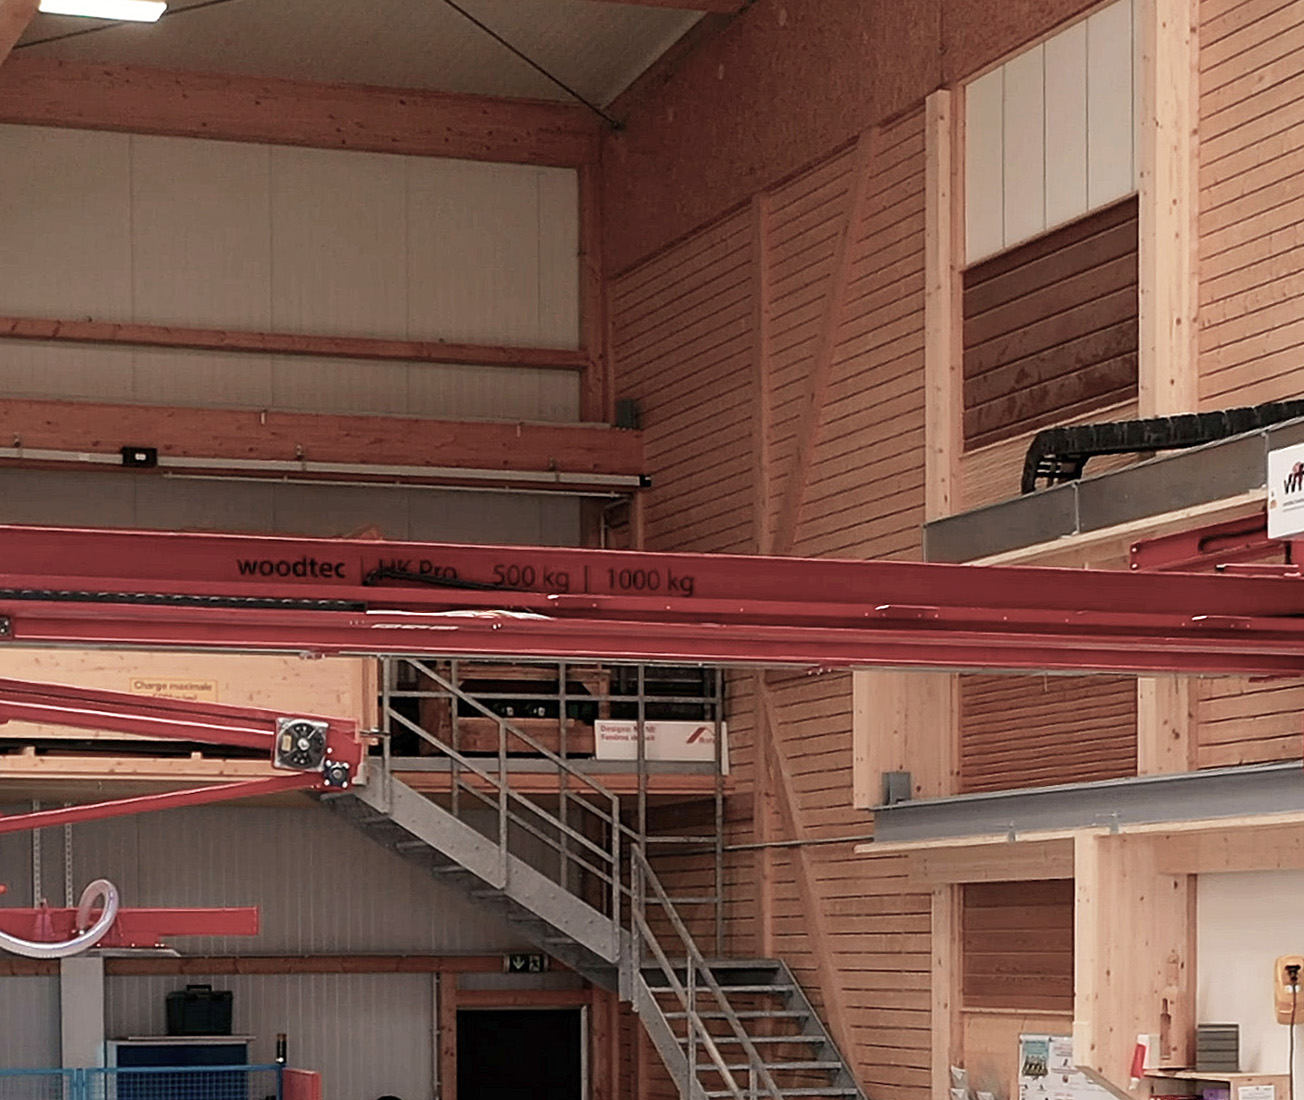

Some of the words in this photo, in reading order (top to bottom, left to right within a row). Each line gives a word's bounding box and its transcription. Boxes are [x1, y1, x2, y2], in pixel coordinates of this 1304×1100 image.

[237, 556, 346, 579] woodtec
[419, 559, 458, 580] Pro
[492, 563, 536, 587] 500
[542, 565, 570, 593] kg
[607, 568, 661, 592] 1000
[667, 568, 695, 598] kg
